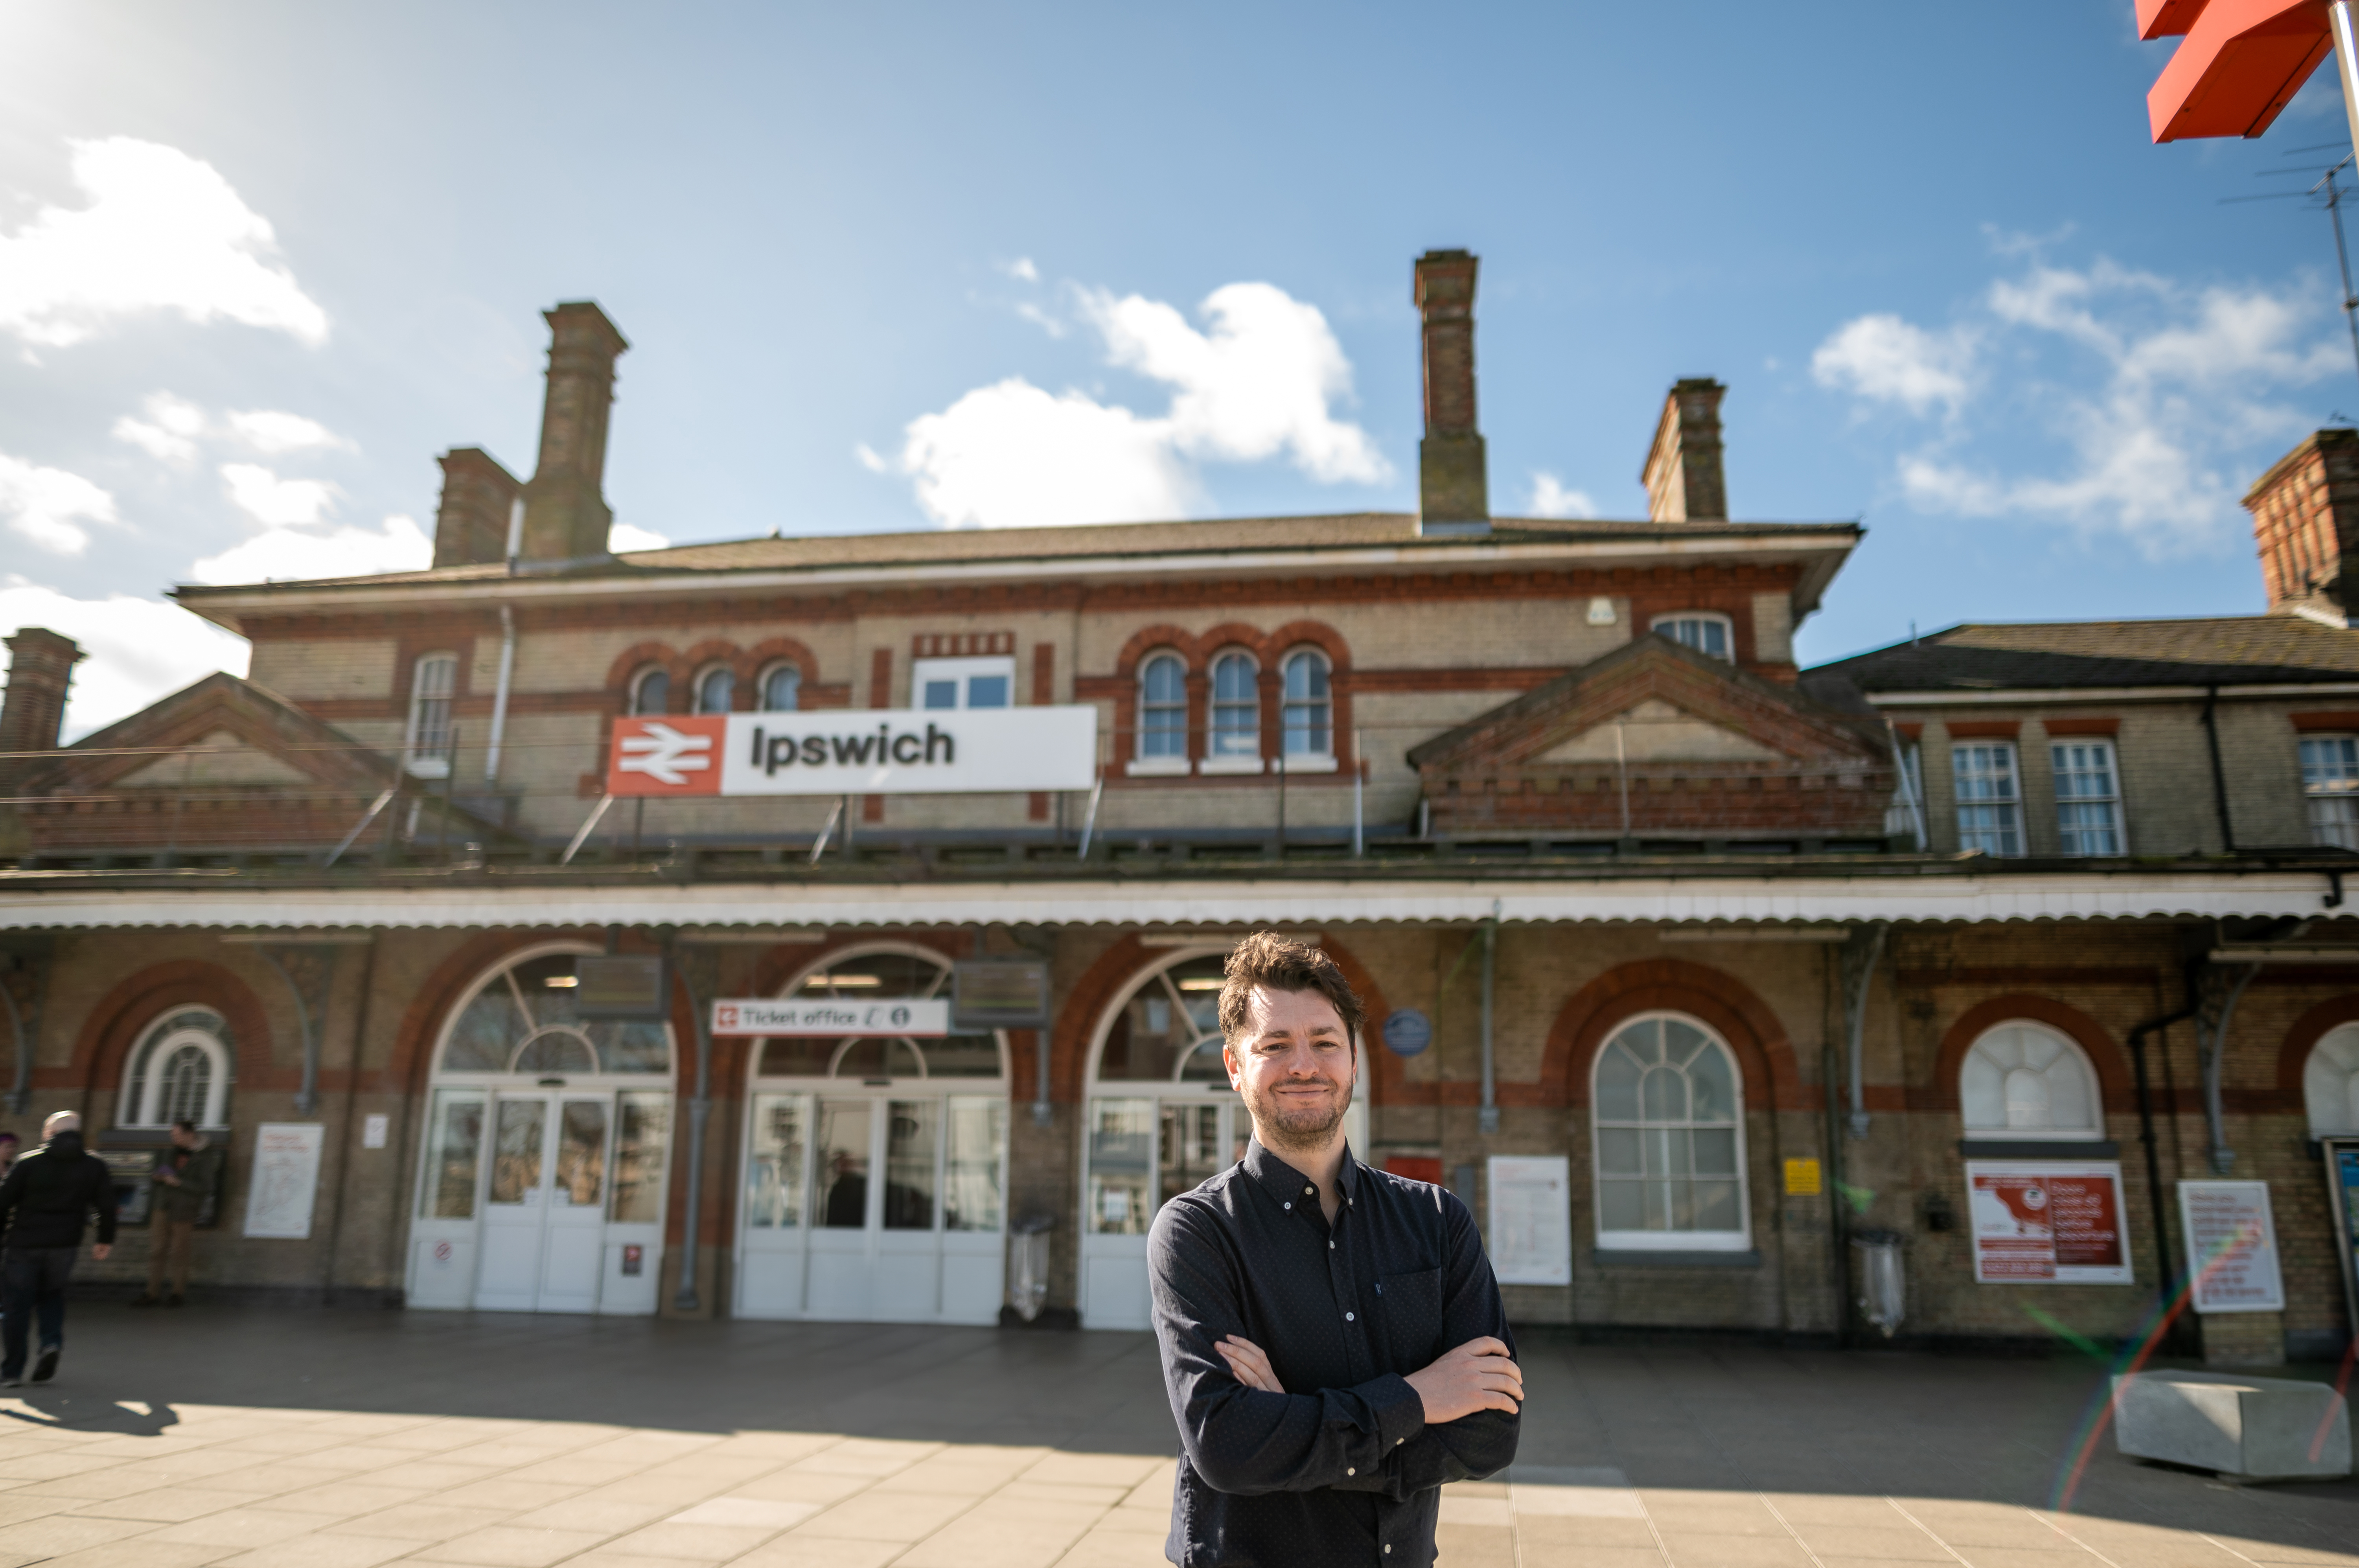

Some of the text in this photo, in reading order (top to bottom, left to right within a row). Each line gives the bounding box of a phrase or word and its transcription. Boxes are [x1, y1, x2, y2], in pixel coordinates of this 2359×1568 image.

[751, 723, 955, 775] Ipswich
[744, 1007, 856, 1027] Ticket office
